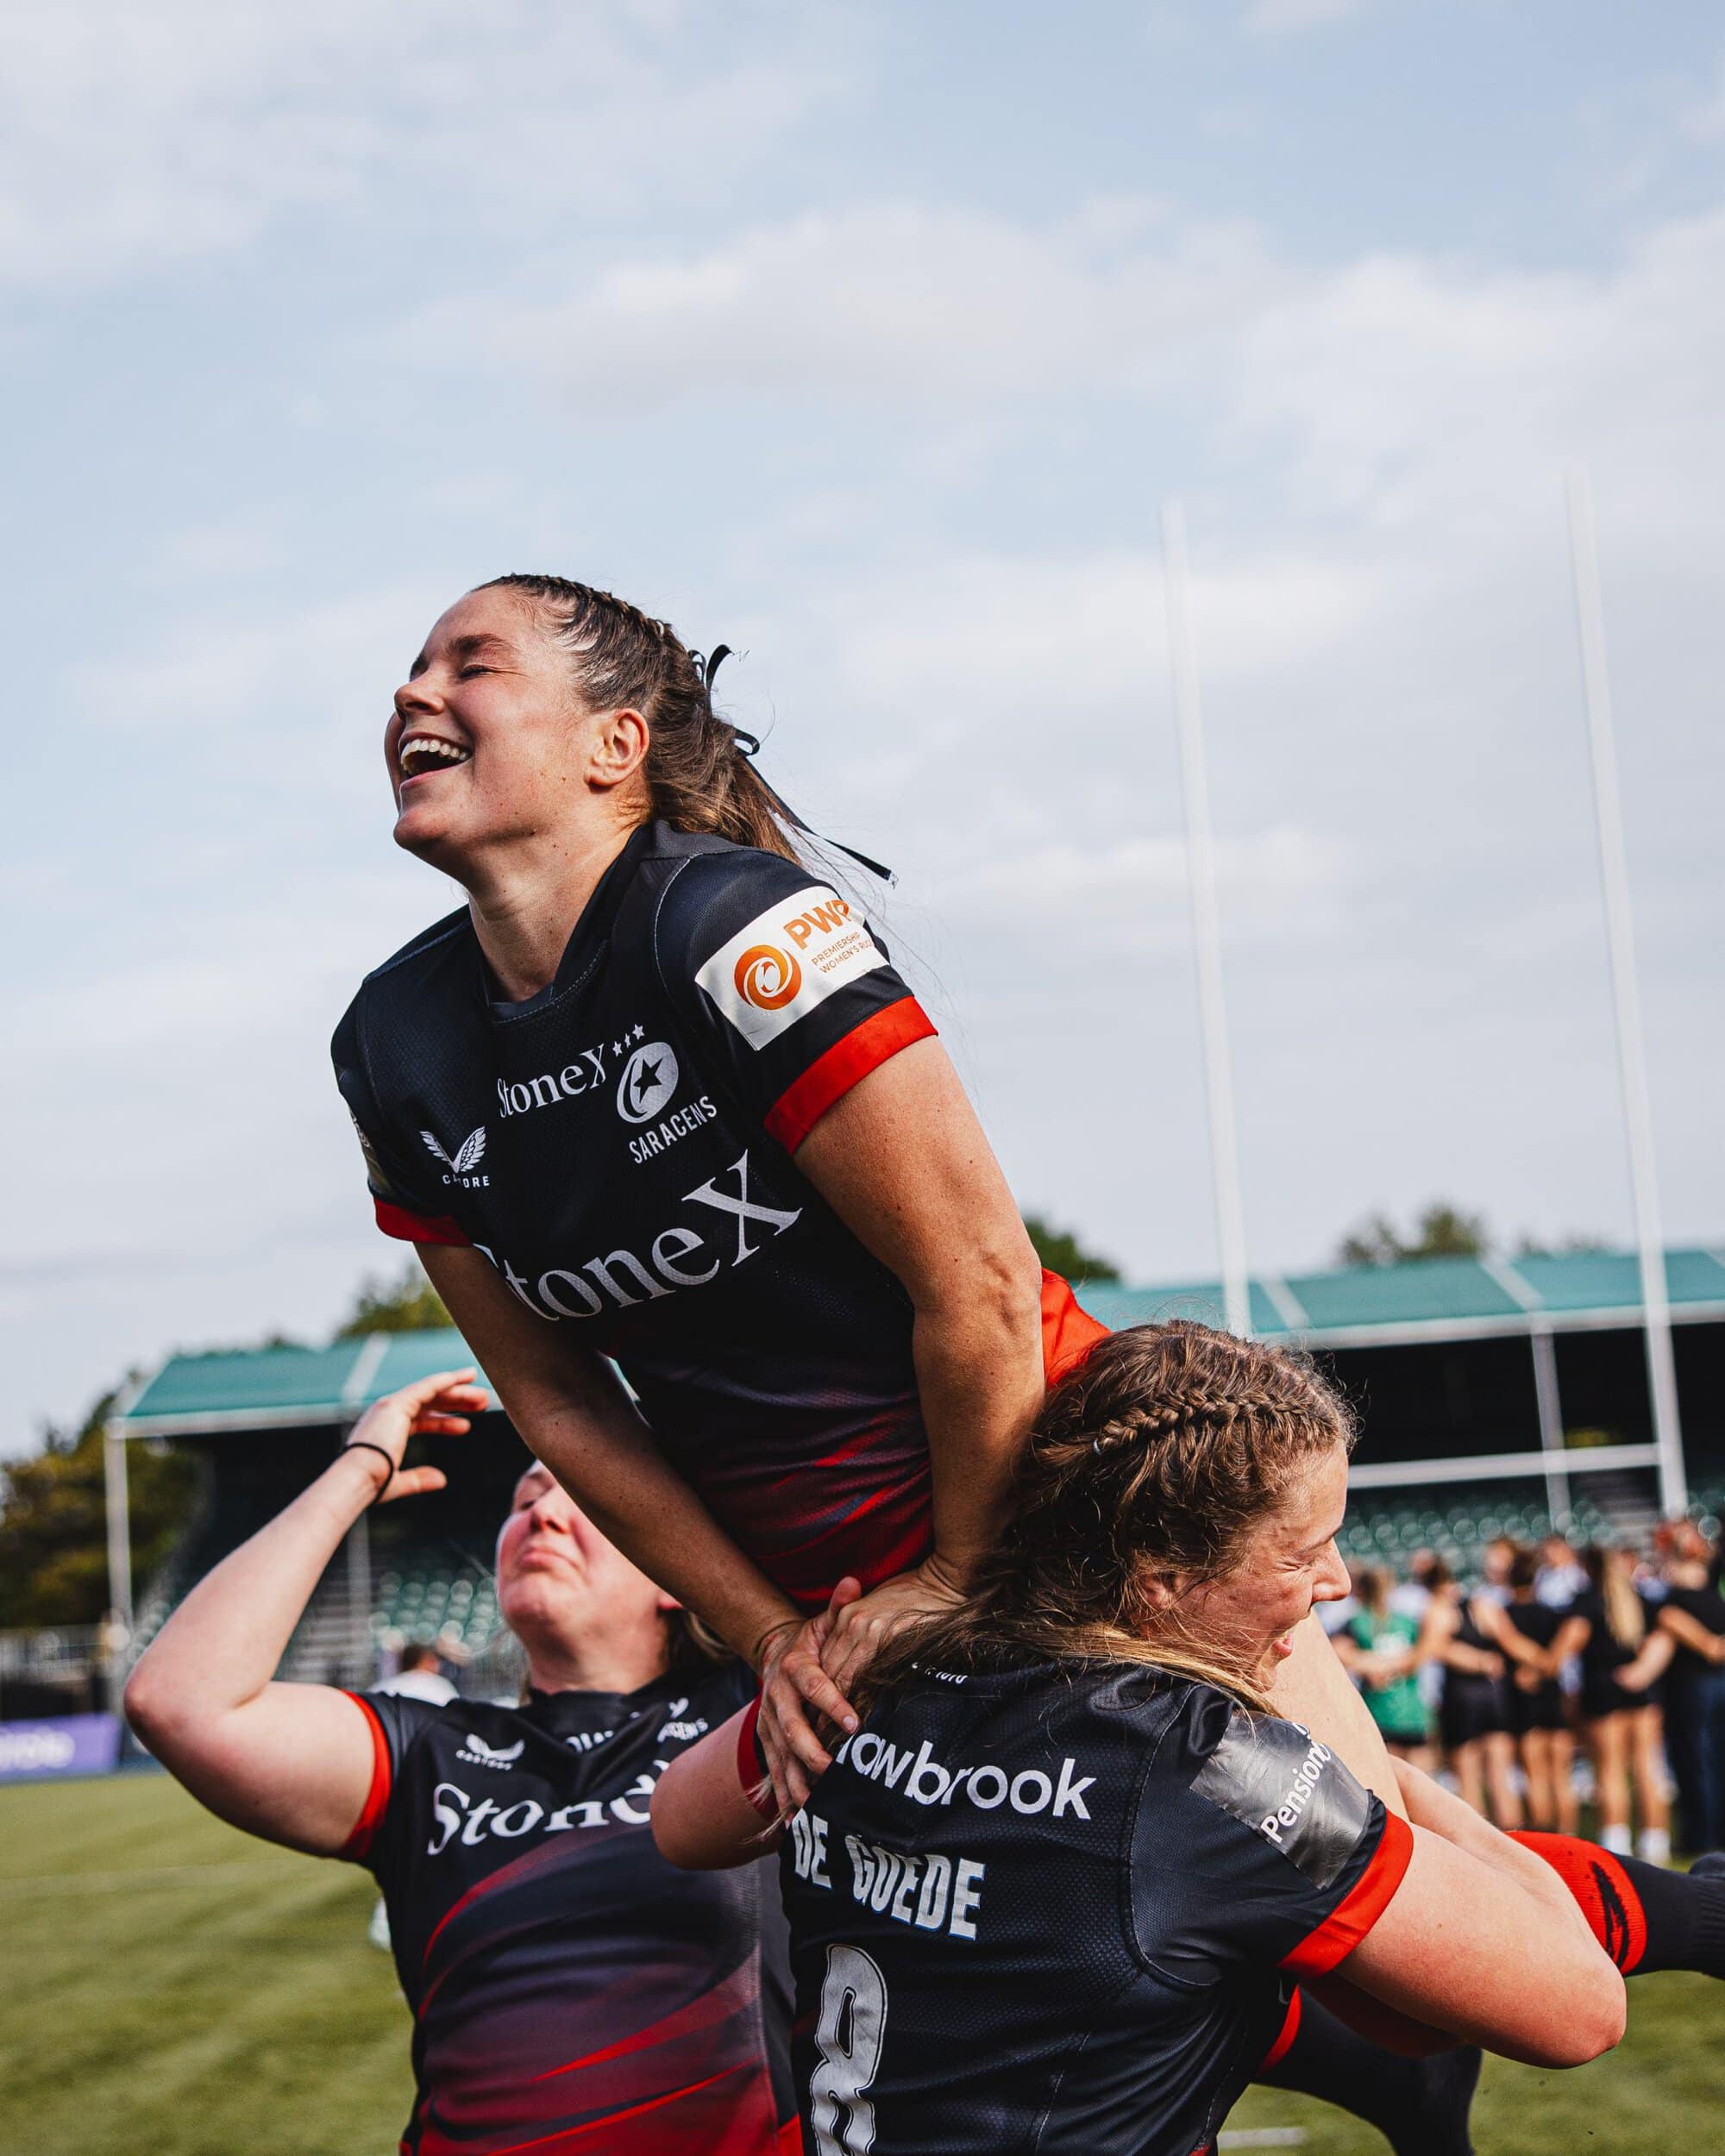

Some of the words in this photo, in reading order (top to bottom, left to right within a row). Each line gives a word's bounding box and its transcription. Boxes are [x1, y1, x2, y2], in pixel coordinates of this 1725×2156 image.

[497, 1043, 606, 1119] StoneX
[629, 1095, 718, 1164] SARACENS
[442, 1173, 490, 1188] CORE
[473, 1149, 803, 1321] toneX
[836, 1732, 1097, 1820] awbrook
[1259, 1732, 1332, 1844] Pension
[791, 1808, 833, 1890] DE
[844, 1834, 987, 1941] GOEDE
[809, 1943, 888, 2156] 8
